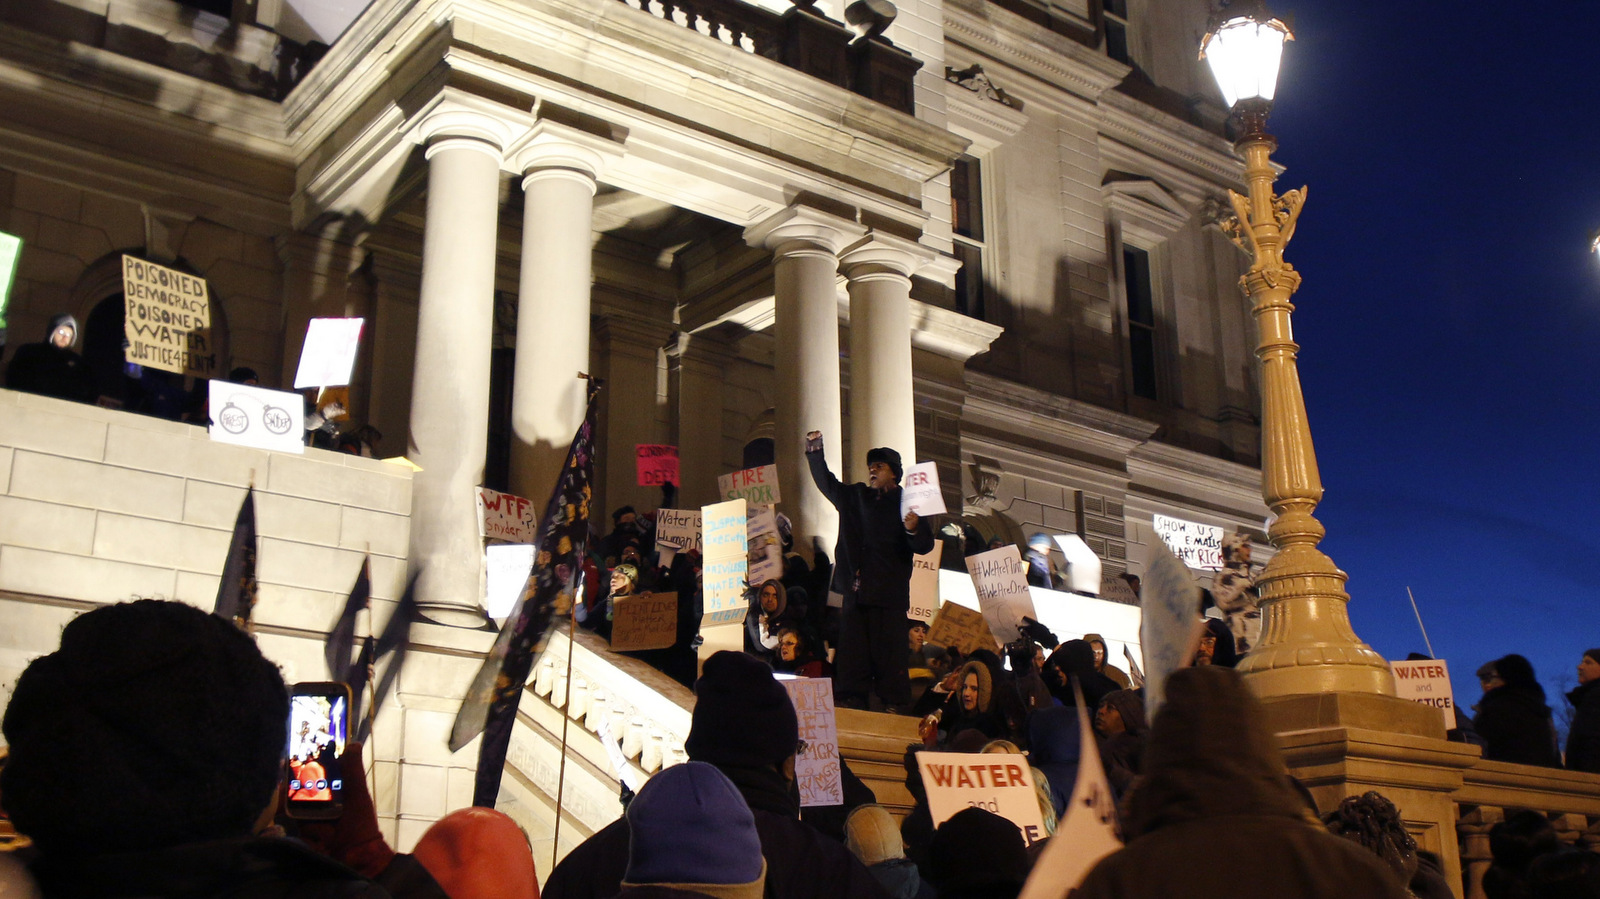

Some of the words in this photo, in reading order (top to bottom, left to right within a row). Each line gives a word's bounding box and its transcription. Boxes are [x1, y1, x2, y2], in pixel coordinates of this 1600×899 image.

[126, 258, 203, 297] POISONED
[127, 280, 207, 316] DEMOCRACY
[128, 299, 204, 331] POISONED
[131, 320, 206, 352] WATER
[731, 465, 766, 489] FIRE
[905, 472, 929, 489] TER
[727, 485, 774, 504] SNYDER
[480, 492, 530, 520] WTF
[485, 517, 521, 537] Snyder
[658, 511, 691, 526] Water
[693, 514, 702, 528] is
[1158, 516, 1186, 532] SHOW
[1197, 525, 1214, 539] US
[971, 556, 1022, 580] #WeAreFlint
[704, 578, 743, 592] WATER
[978, 580, 1029, 601] #WeAreOne
[710, 608, 746, 622] RIGHT
[1394, 666, 1446, 680] WATER
[1415, 683, 1432, 692] and
[925, 763, 1029, 789] WATER
